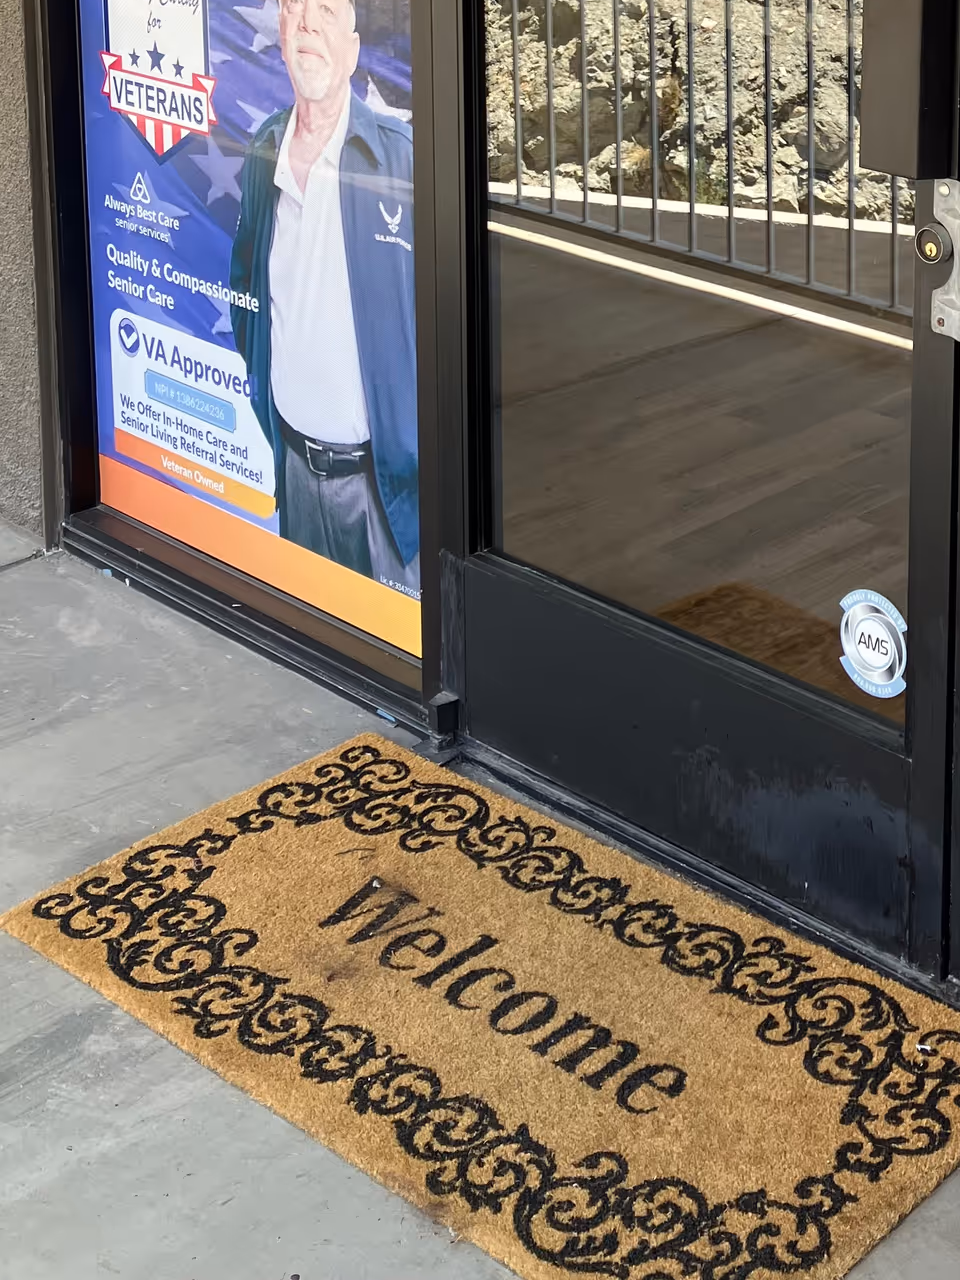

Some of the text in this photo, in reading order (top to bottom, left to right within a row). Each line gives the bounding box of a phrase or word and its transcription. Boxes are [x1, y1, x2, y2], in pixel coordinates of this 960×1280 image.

[147, 10, 162, 33] for
[112, 75, 204, 126] VETERANS
[104, 194, 180, 231] Always Best Care
[115, 217, 139, 233] senior
[106, 243, 259, 312] Quality & Compassionate
[107, 270, 174, 310] Senior Care
[142, 332, 258, 401] VA Approved!
[154, 382, 169, 397] NPI
[119, 393, 248, 460] We Offer In-Home Care and
[120, 411, 263, 485] Senior Living Referral Services!
[160, 454, 225, 494] Veteran Owned
[857, 631, 889, 656] AMS
[318, 875, 688, 1114] Welcome
